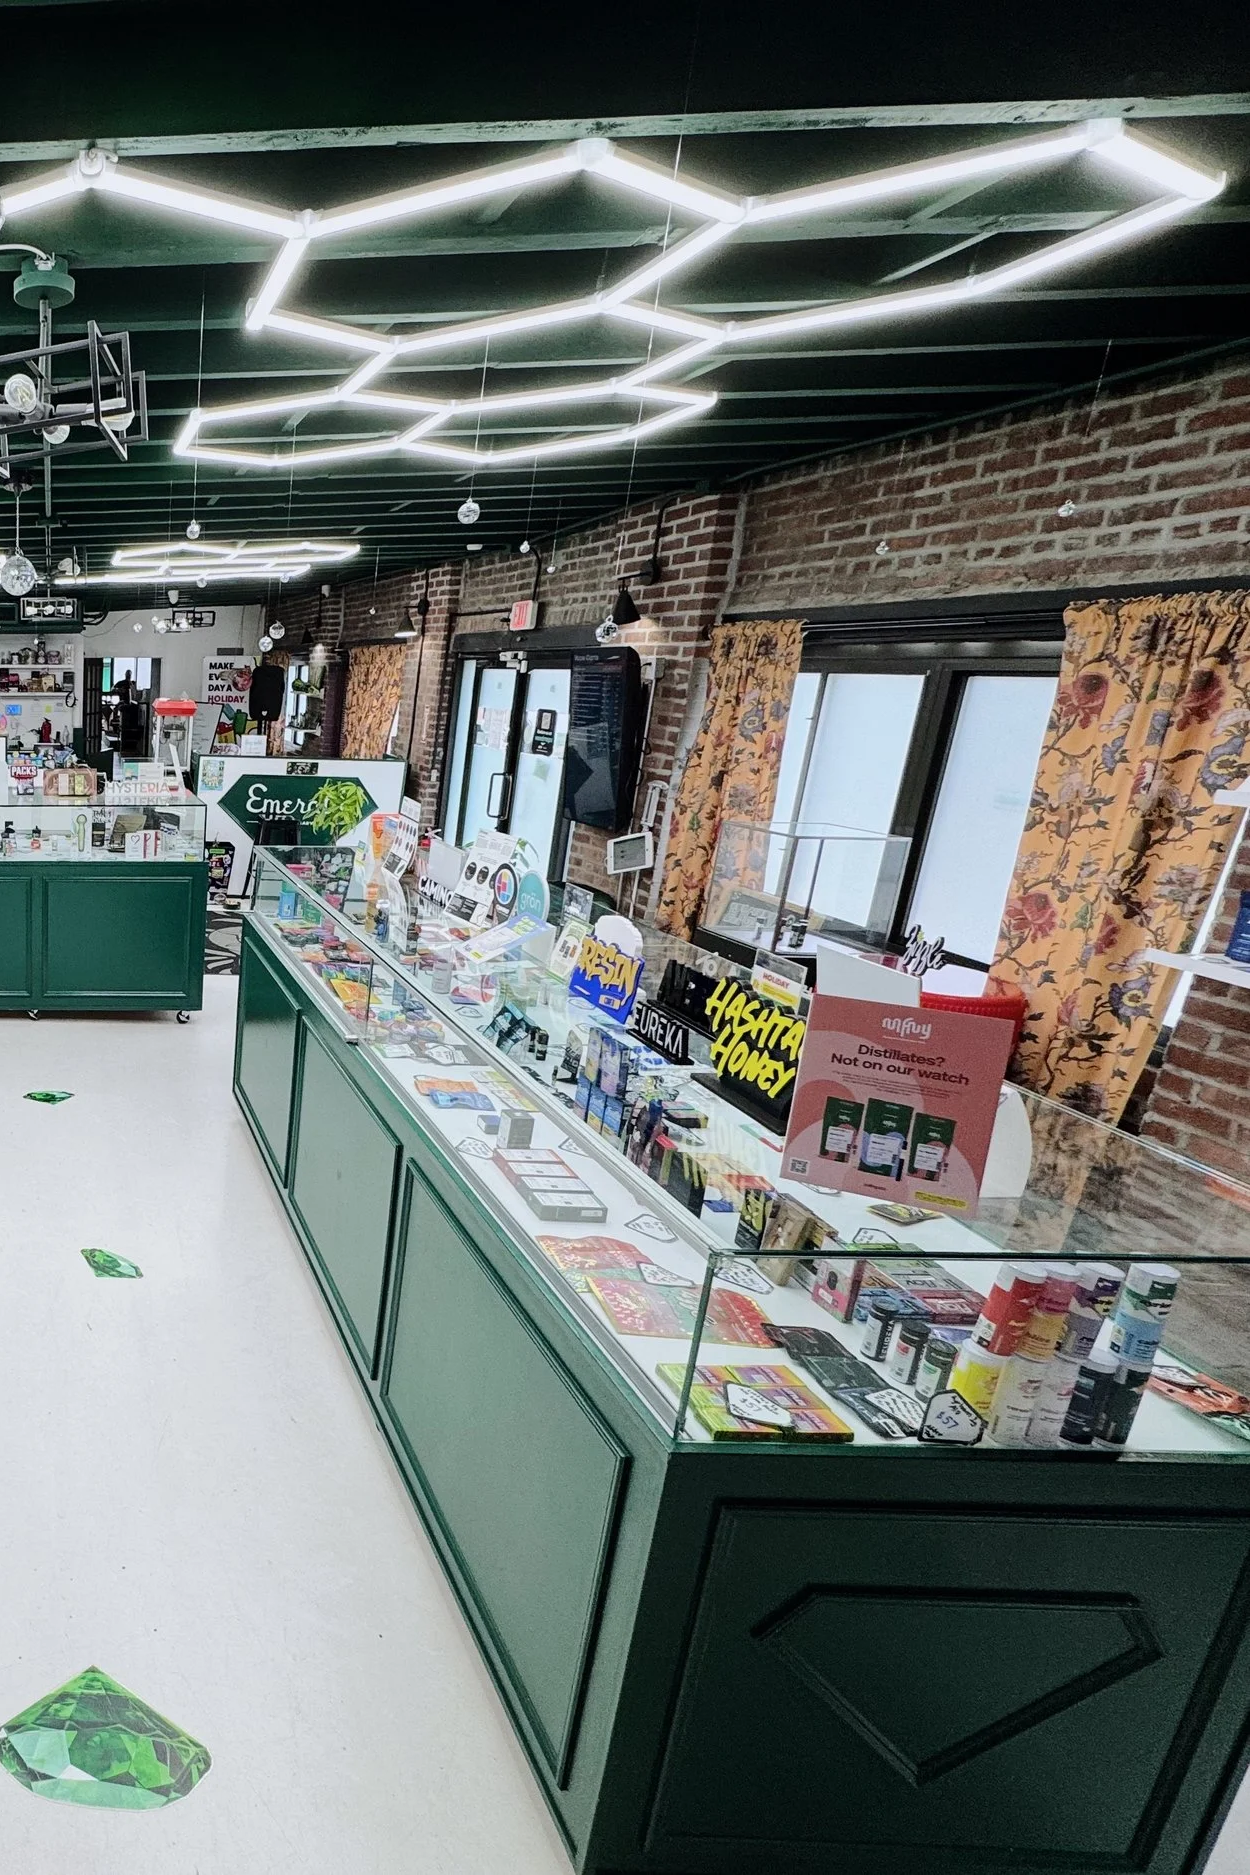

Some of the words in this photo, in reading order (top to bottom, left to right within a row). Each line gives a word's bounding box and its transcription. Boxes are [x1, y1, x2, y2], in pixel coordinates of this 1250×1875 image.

[209, 662, 234, 670] MAKE
[208, 684, 226, 692] DAY
[226, 684, 232, 692] A
[11, 765, 37, 776] PACKS
[106, 781, 170, 793] HYSTERIA
[418, 875, 455, 909] CAMINO
[578, 934, 640, 1000] RESIN
[762, 972, 790, 990] HOLIDAY
[634, 1002, 683, 1058] EUREKA
[705, 976, 807, 1062] HASHTA
[710, 1023, 796, 1099] HONEY
[831, 1053, 861, 1067] Not
[862, 1060, 883, 1071] on
[886, 1065, 915, 1076] our
[917, 1069, 970, 1086] watch
[858, 1044, 946, 1067] Distillates?
